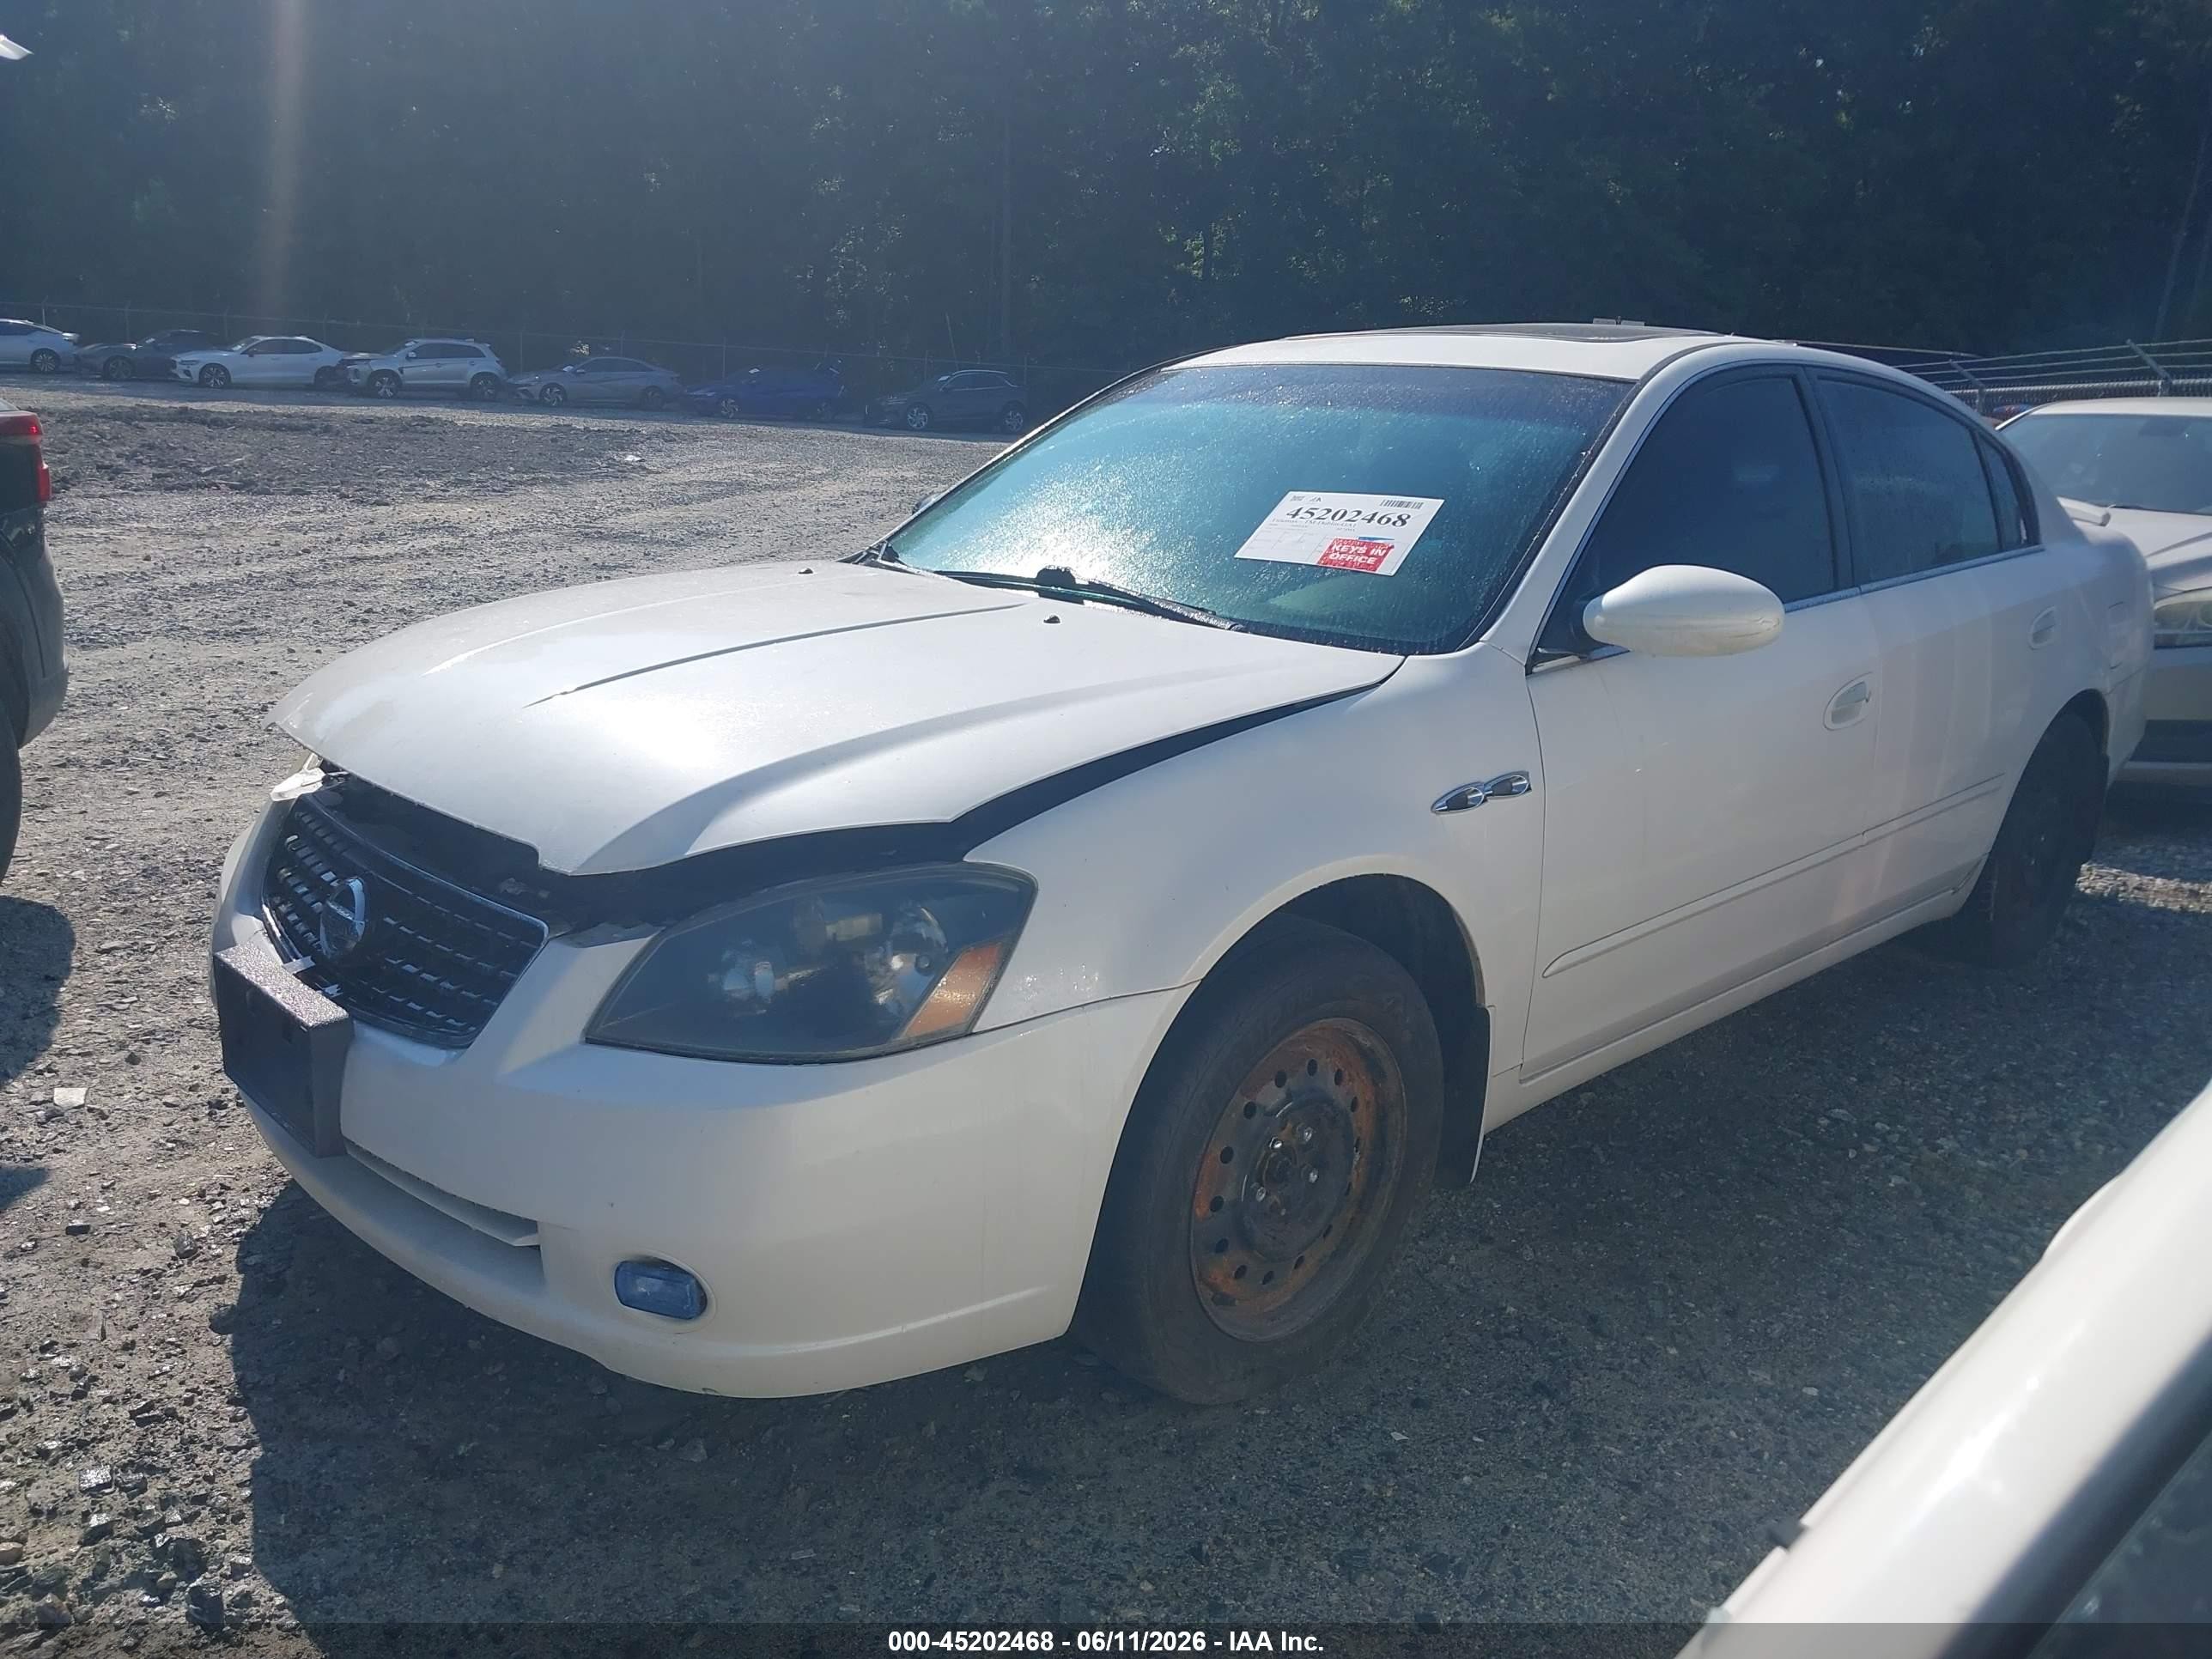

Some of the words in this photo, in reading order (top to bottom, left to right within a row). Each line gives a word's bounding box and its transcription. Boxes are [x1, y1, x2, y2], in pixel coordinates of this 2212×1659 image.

[1286, 507, 1411, 527] 45202468
[1331, 544, 1368, 554] KEYS
[1370, 548, 1387, 556] IN
[1328, 553, 1377, 564] OFFICE
